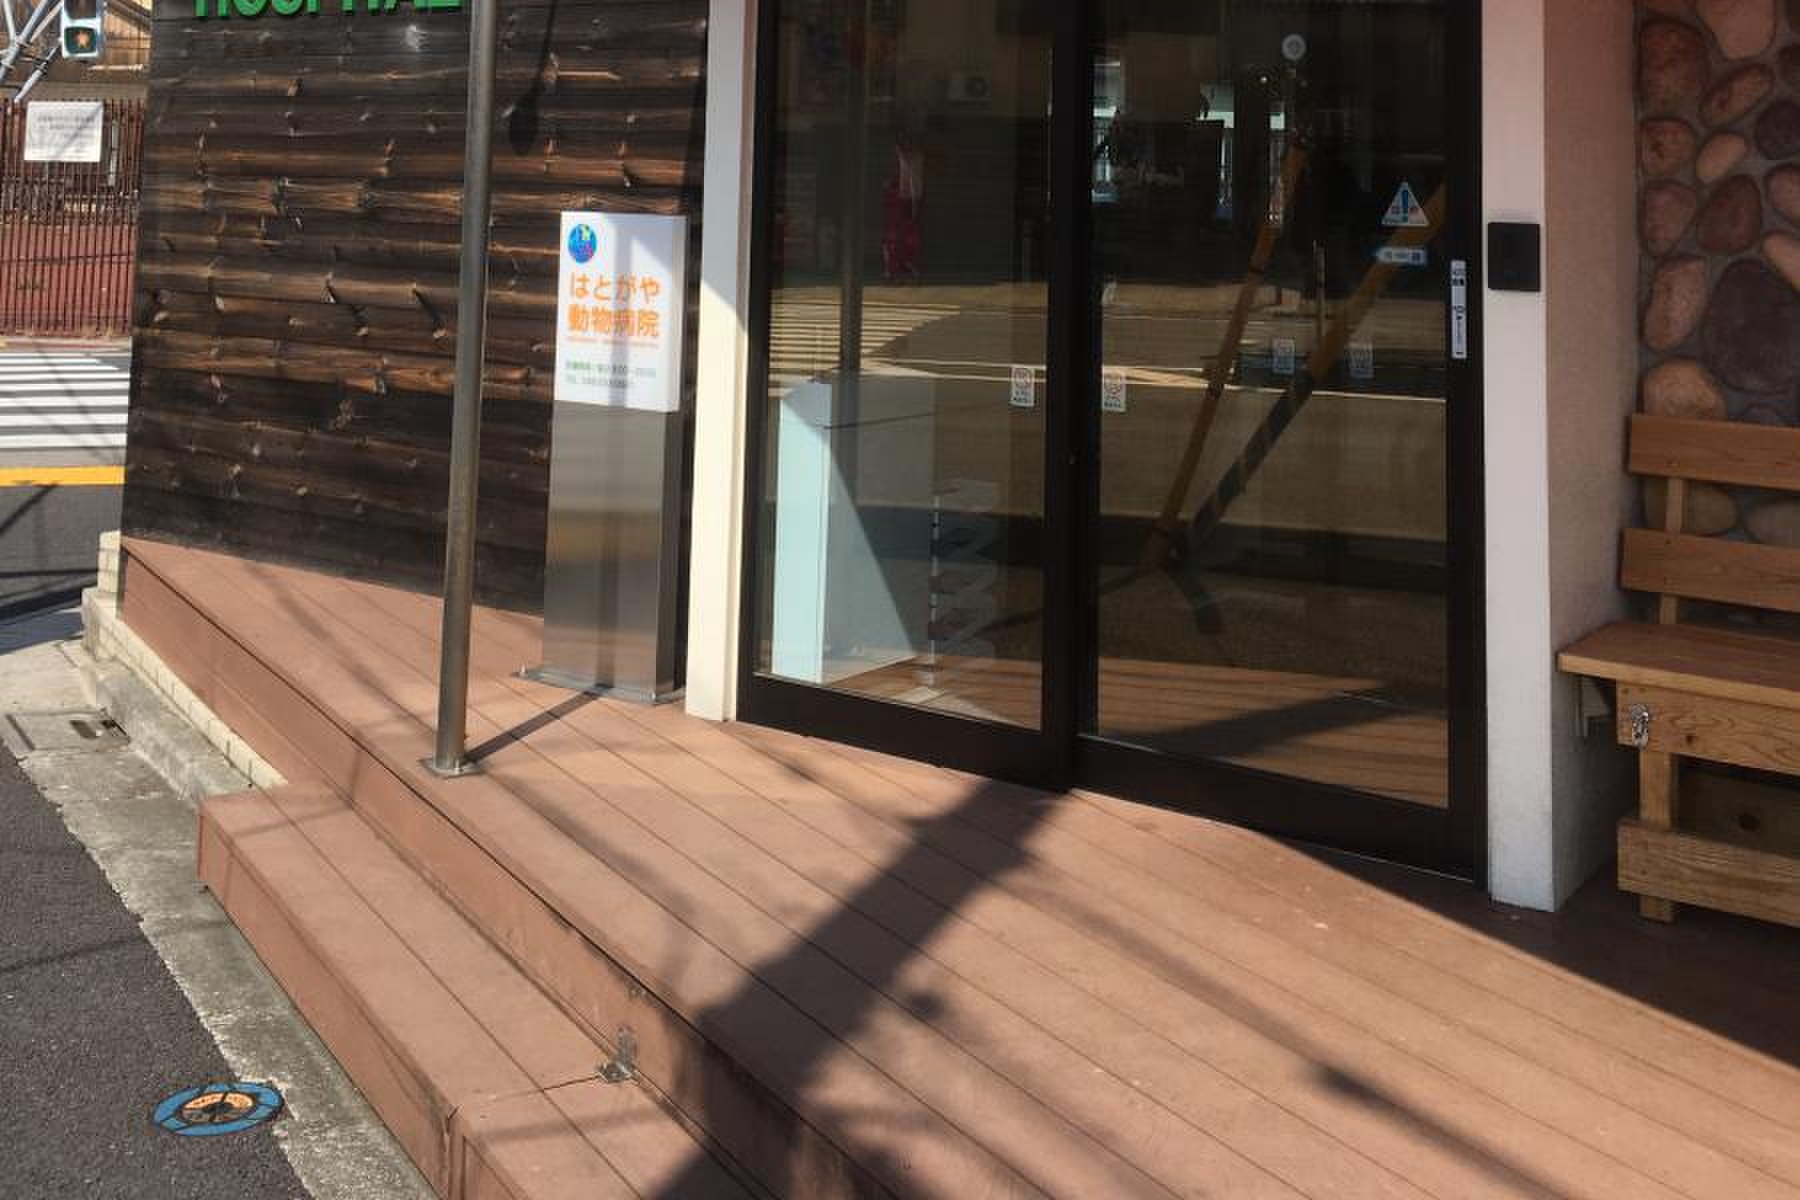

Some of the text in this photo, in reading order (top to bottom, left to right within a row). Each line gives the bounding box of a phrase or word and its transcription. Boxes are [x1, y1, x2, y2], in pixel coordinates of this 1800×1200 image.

[568, 273, 661, 303] はとがや
[566, 304, 661, 338] 動物病院
